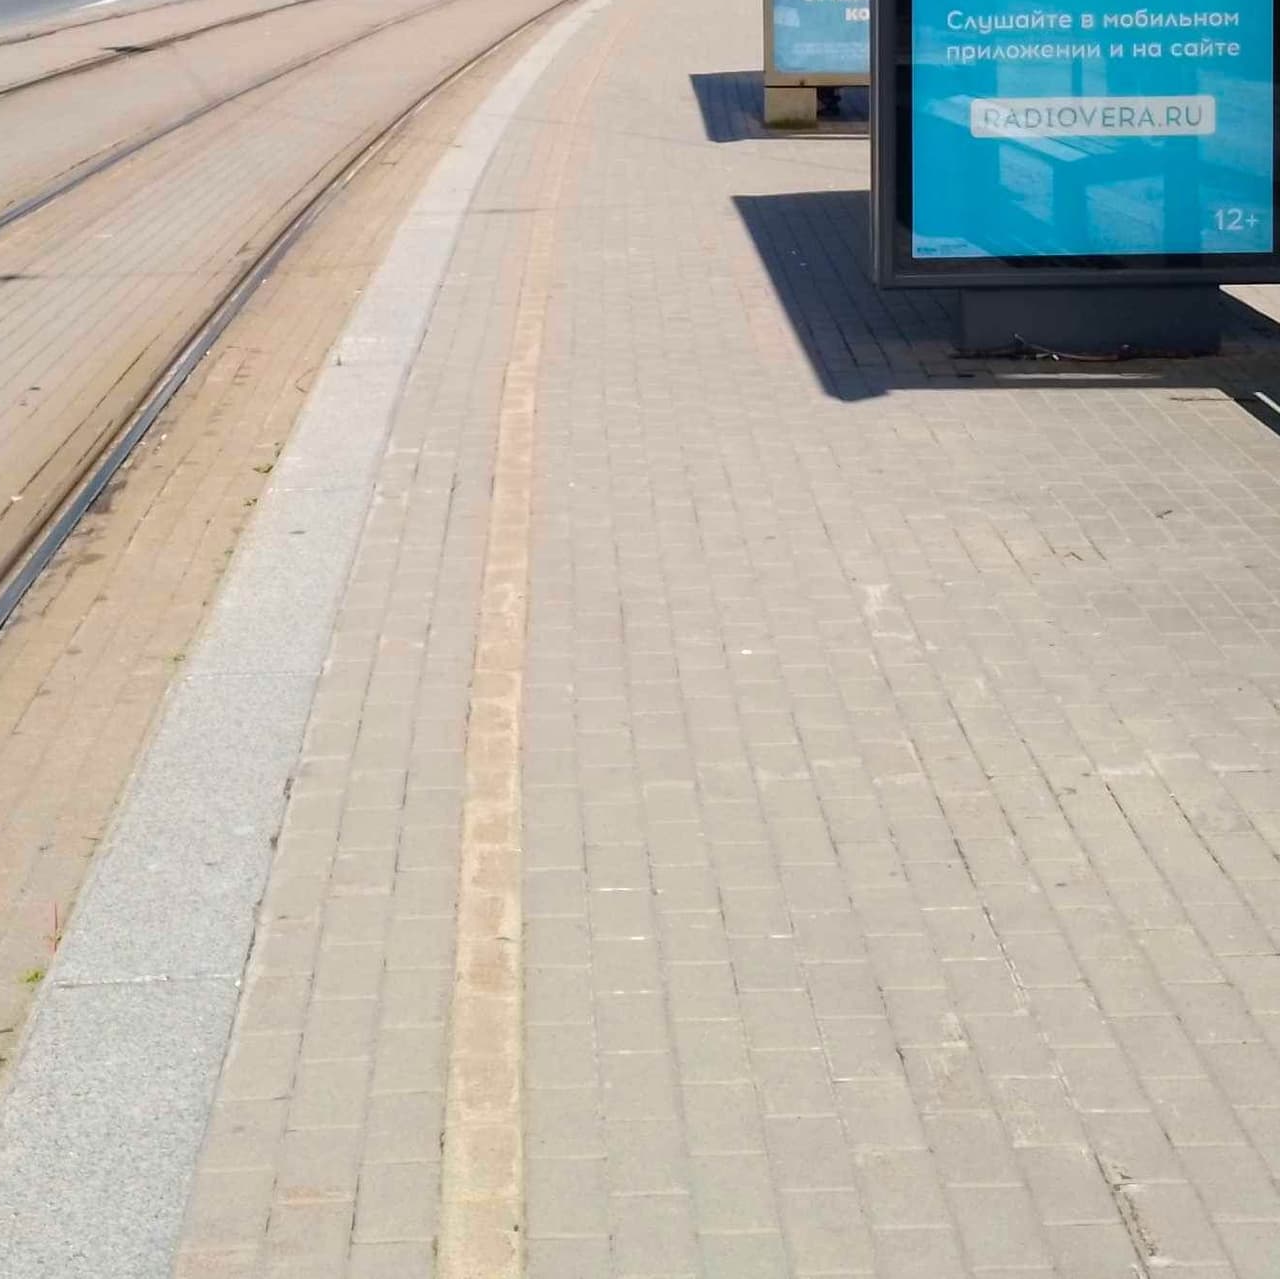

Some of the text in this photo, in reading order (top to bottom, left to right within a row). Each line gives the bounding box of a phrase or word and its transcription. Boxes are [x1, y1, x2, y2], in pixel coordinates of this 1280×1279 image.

[845, 7, 870, 21] ко
[946, 8, 1240, 34] Слушайте в мобильном
[946, 36, 1240, 63] приложении и на сайте
[983, 105, 1203, 130] RADIOVERA.RU
[1215, 208, 1260, 231] 12+
